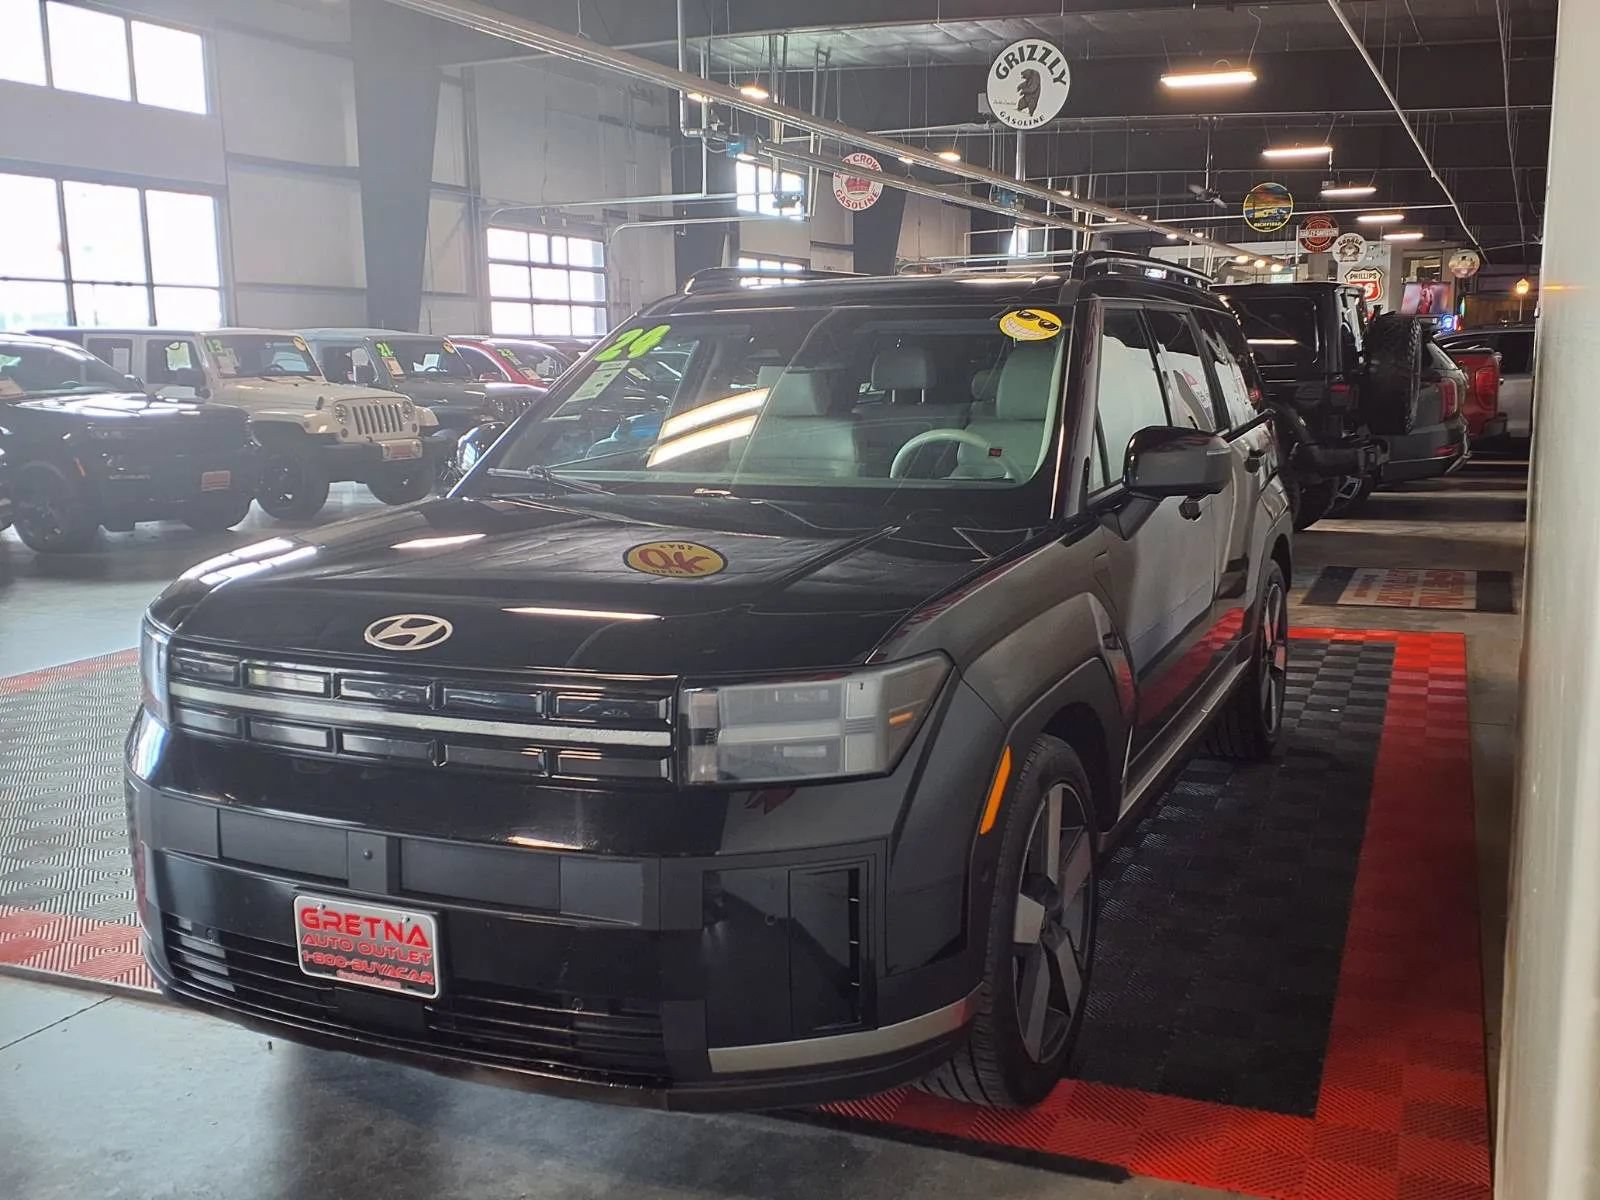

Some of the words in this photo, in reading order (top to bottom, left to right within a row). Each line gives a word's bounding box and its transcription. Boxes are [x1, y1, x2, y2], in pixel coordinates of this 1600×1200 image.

[995, 44, 1067, 86] GRIZZLY
[1000, 111, 1046, 127] GASOLINE
[853, 154, 881, 174] CROW
[836, 189, 880, 209] GASOLINE
[1350, 272, 1377, 280] PHILLIPS
[300, 907, 430, 949] GRETNA
[302, 933, 353, 952] AUTO
[358, 941, 432, 967] OUTLET
[302, 950, 435, 986] 1-800-BUYACAR
